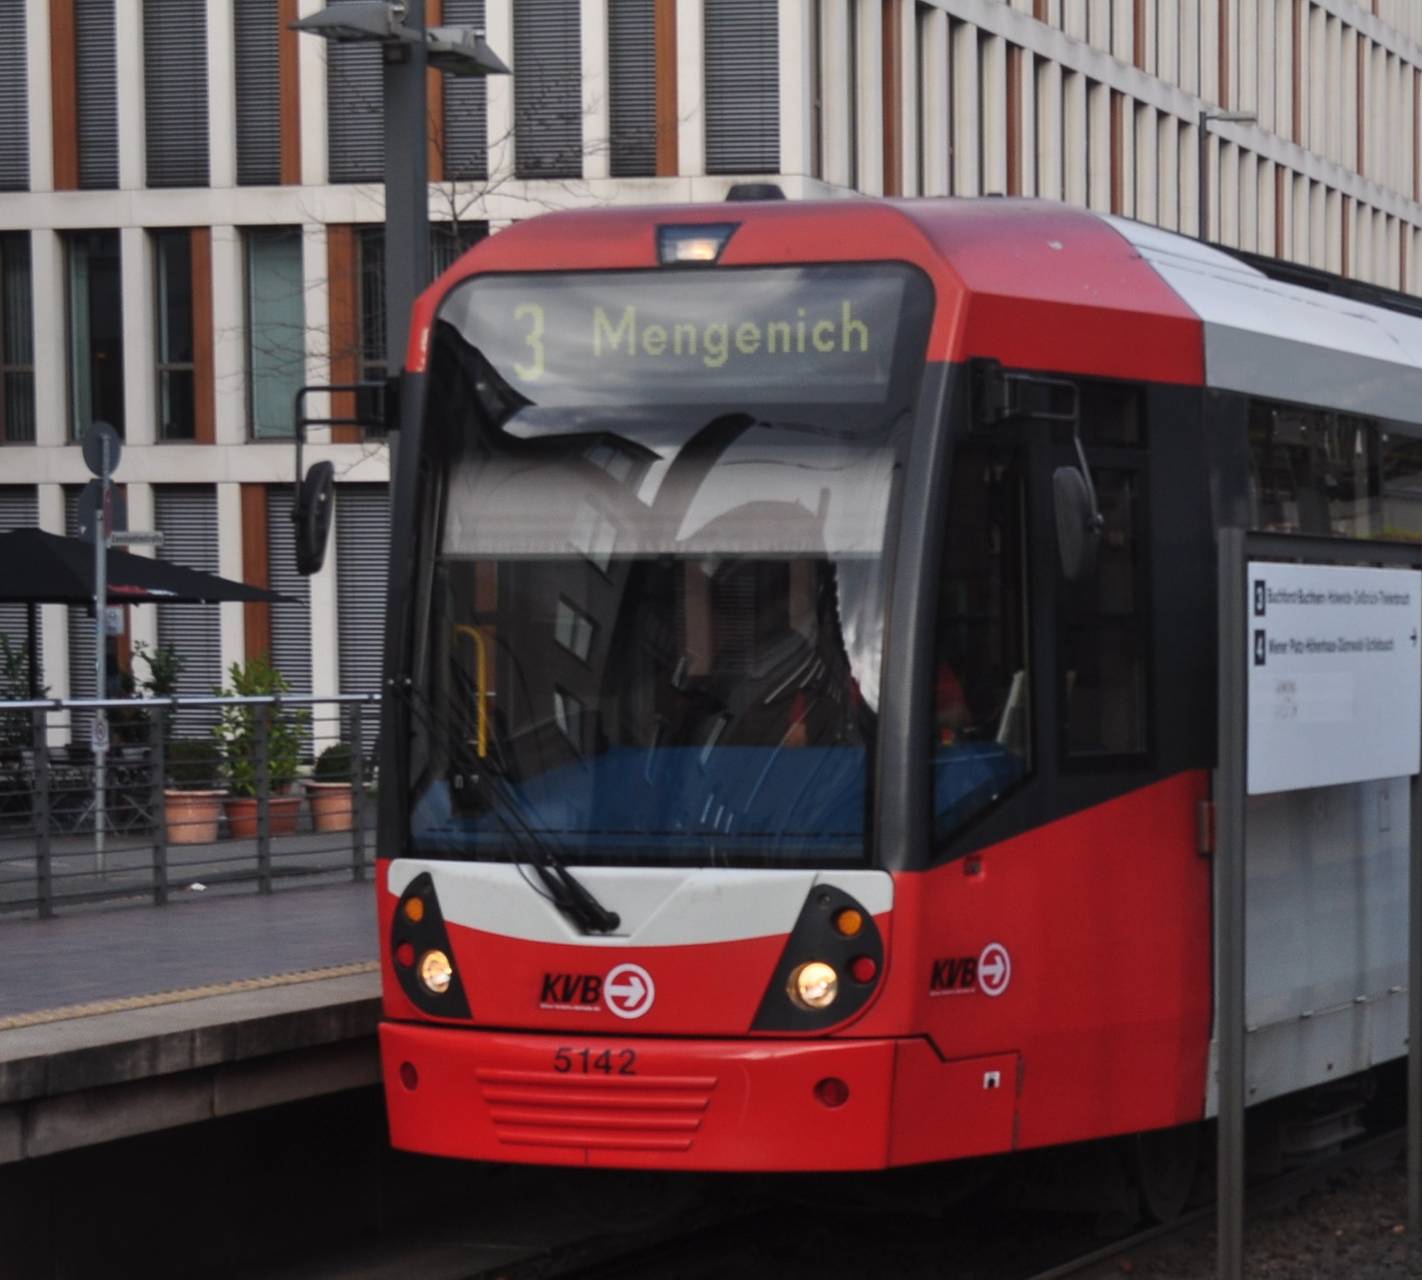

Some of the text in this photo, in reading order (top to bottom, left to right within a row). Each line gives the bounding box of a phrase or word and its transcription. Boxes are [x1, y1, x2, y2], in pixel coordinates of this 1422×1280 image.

[512, 301, 870, 380] 3 Mengenich
[539, 973, 602, 1004] KVB
[929, 956, 979, 990] KVB
[553, 1046, 638, 1076] 5142
